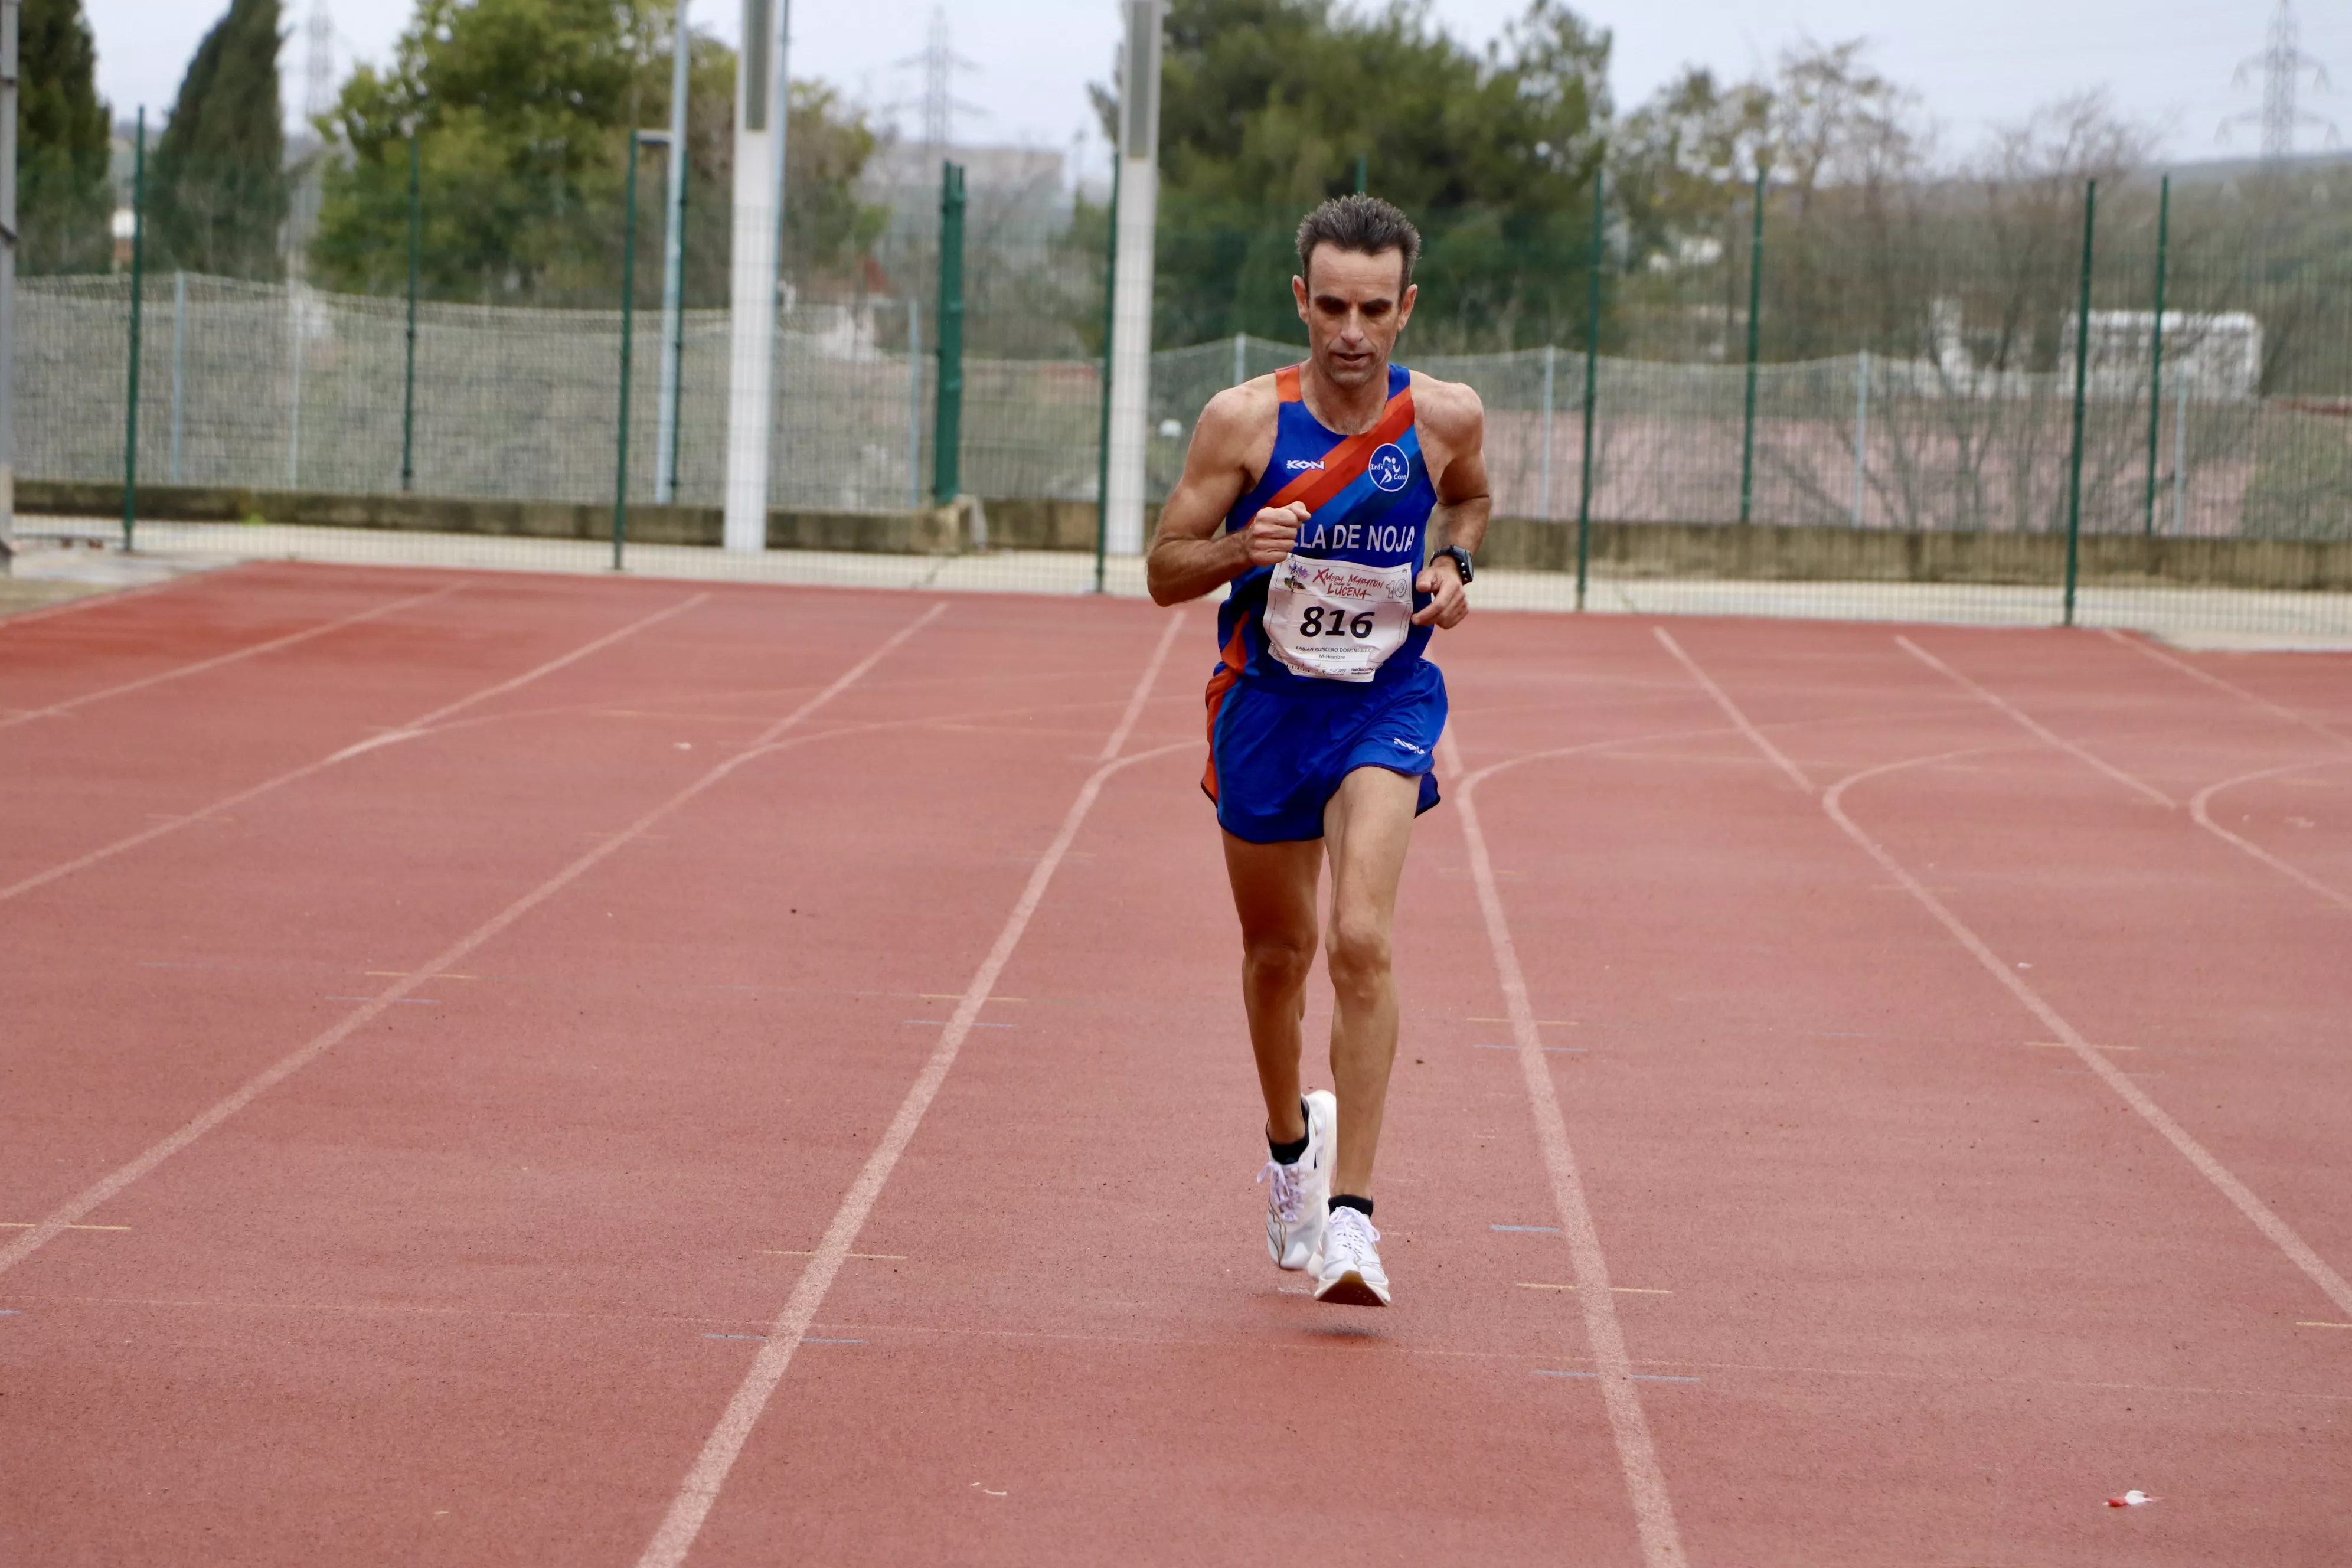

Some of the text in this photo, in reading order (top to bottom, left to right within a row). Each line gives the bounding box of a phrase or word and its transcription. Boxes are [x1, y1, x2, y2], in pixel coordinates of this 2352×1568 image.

[1294, 523, 1415, 552] LA DE NOJA
[1327, 583, 1373, 599] LUCENA
[1299, 606, 1375, 638] 816
